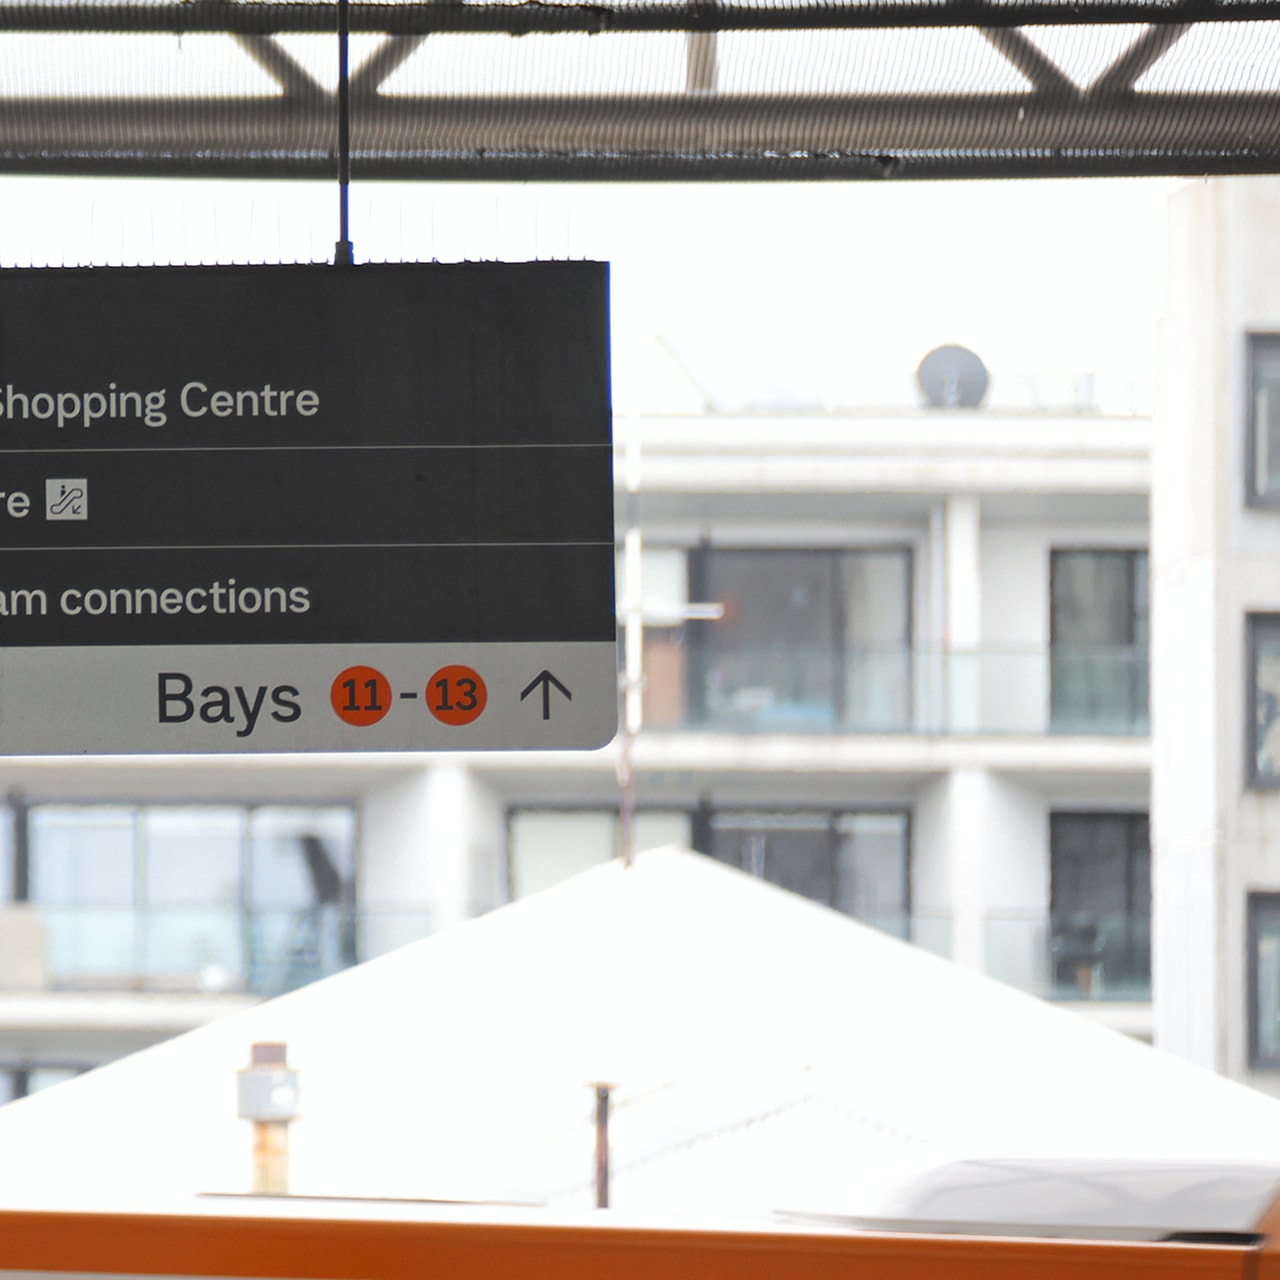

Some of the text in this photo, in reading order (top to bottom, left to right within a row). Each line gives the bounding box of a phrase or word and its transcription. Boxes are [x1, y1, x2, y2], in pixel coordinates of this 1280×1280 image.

[180, 381, 320, 418] Centre
[60, 578, 311, 615] connections
[157, 672, 302, 738] Bays
[342, 679, 383, 711] 11
[435, 678, 478, 711] 13
